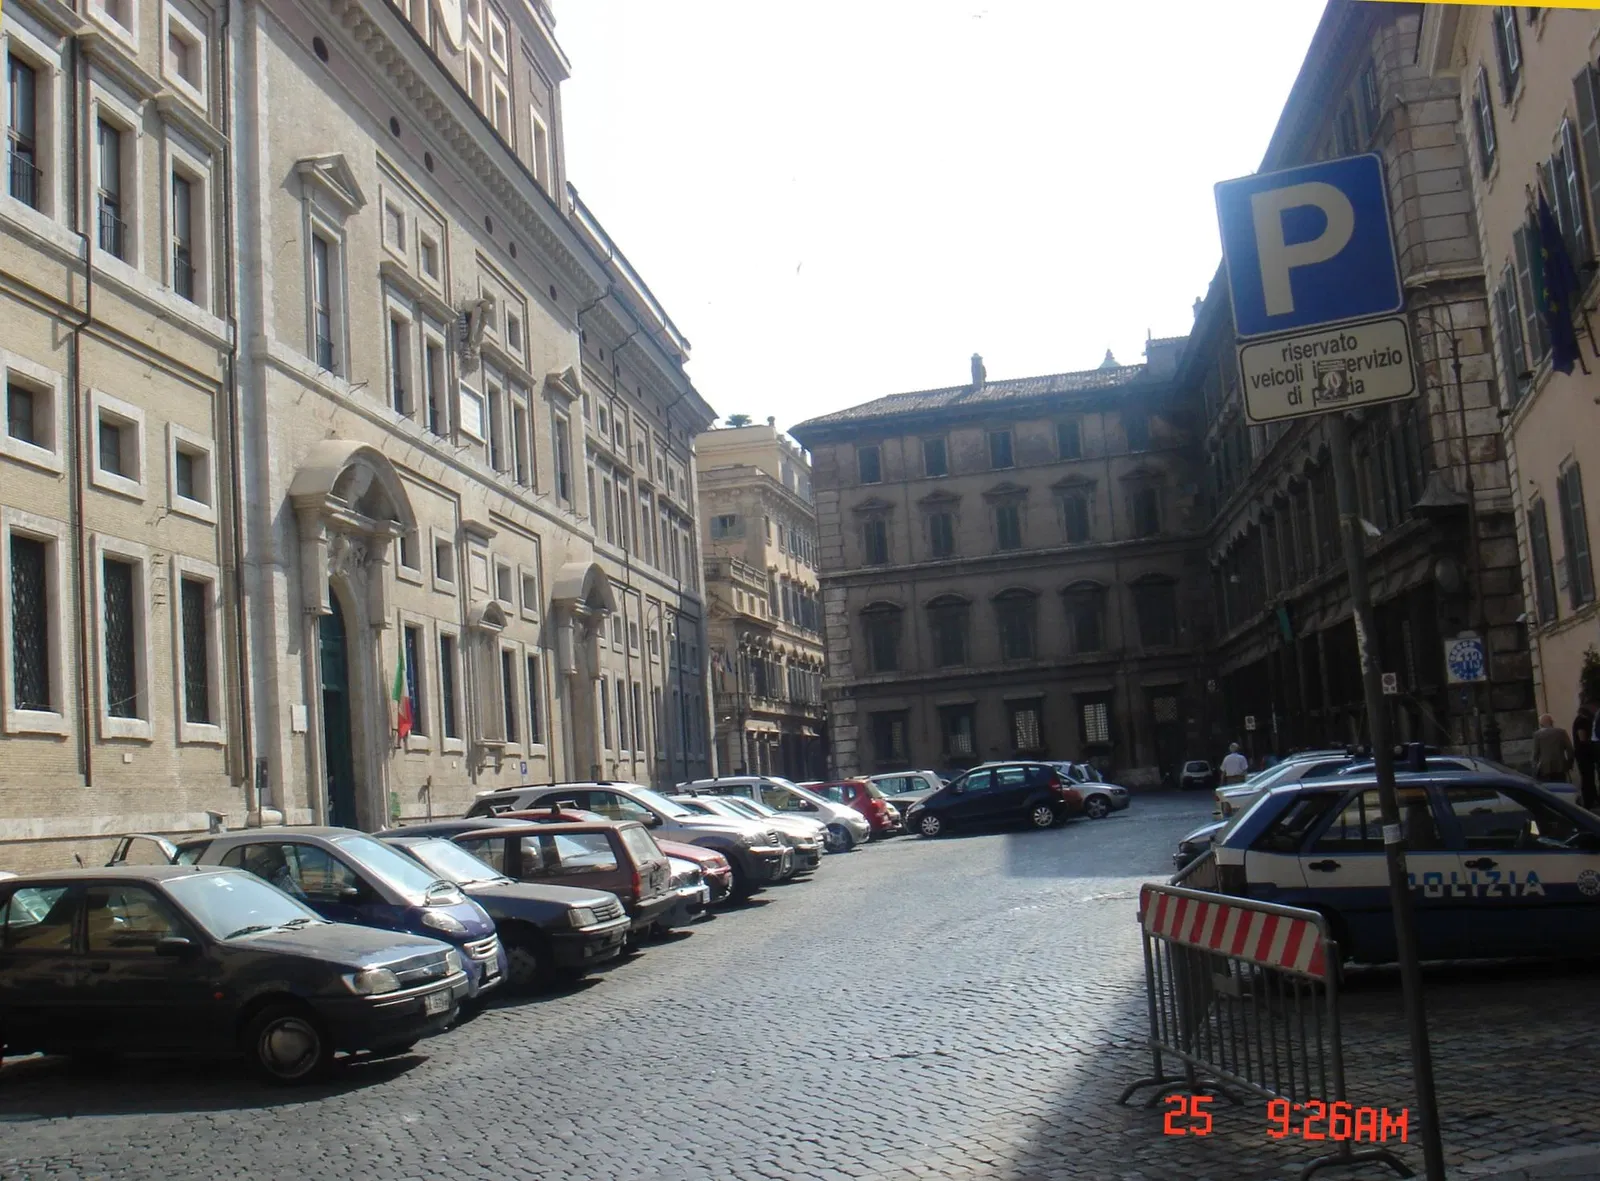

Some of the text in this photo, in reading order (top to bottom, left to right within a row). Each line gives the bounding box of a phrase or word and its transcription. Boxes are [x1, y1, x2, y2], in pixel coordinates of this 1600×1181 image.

[1251, 181, 1355, 317] P
[1281, 333, 1358, 362] riservato
[1251, 364, 1304, 389] veicoli
[1346, 347, 1403, 373] ervizio
[1287, 387, 1303, 406] di
